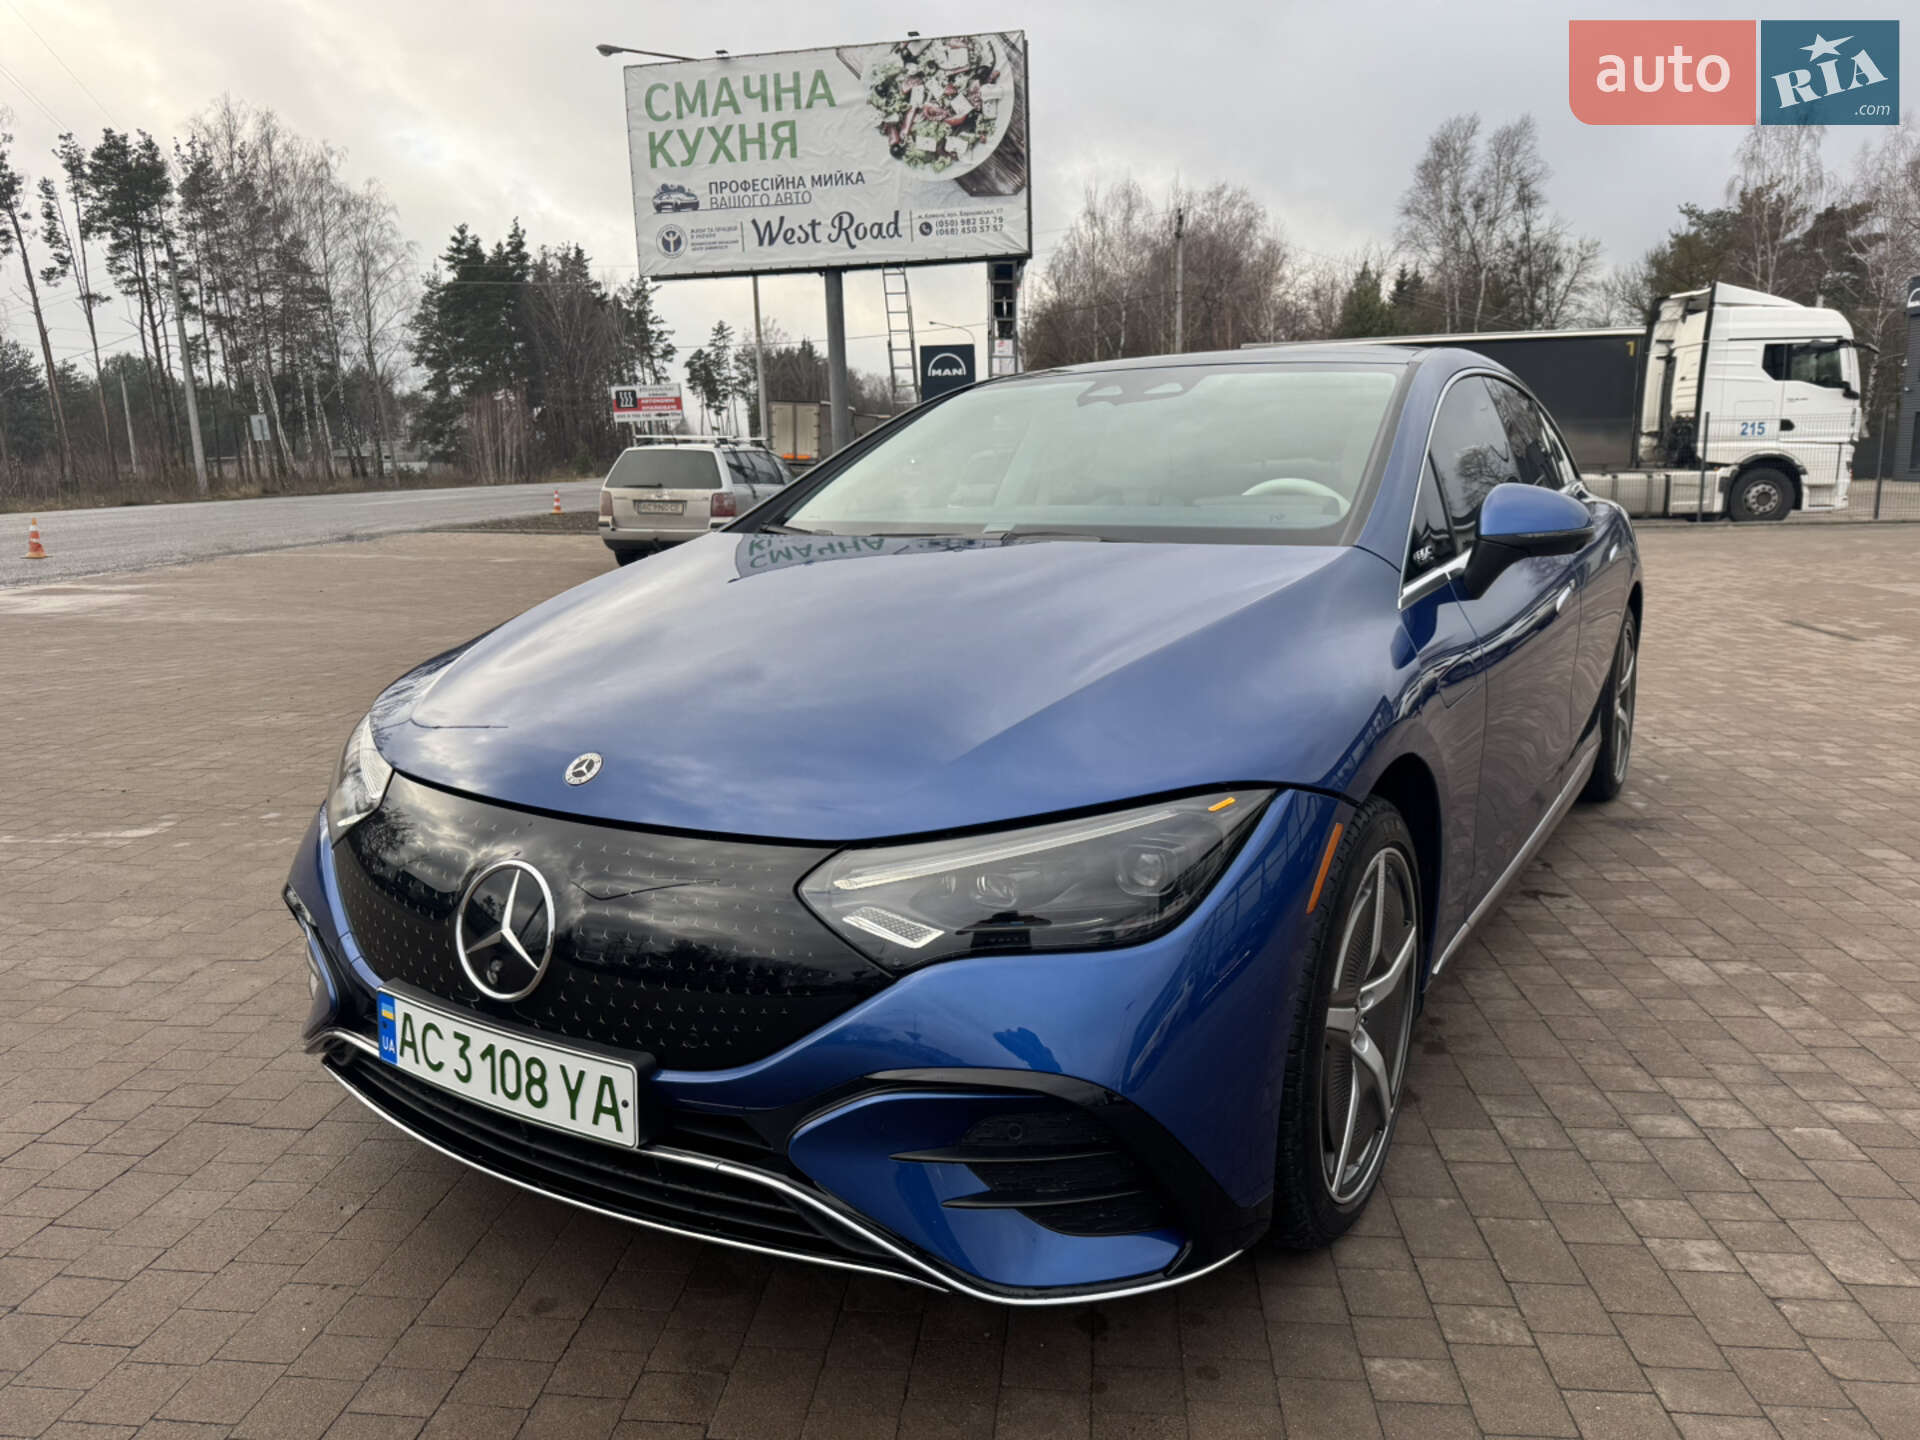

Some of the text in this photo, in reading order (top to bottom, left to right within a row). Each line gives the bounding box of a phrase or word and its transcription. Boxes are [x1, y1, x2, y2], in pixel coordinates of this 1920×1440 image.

[644, 68, 836, 123] СМАЧНА
[647, 120, 798, 169] КУХНЯ
[709, 170, 865, 195] ПРОФЕСІЙНА МИЙКА
[710, 190, 812, 209] ВАШОГО АВТО
[751, 210, 902, 249] West Road
[931, 368, 964, 376] MAN
[1740, 421, 1766, 436] 215
[381, 1035, 396, 1054] UA
[400, 1012, 623, 1132] AC 3108 YA
